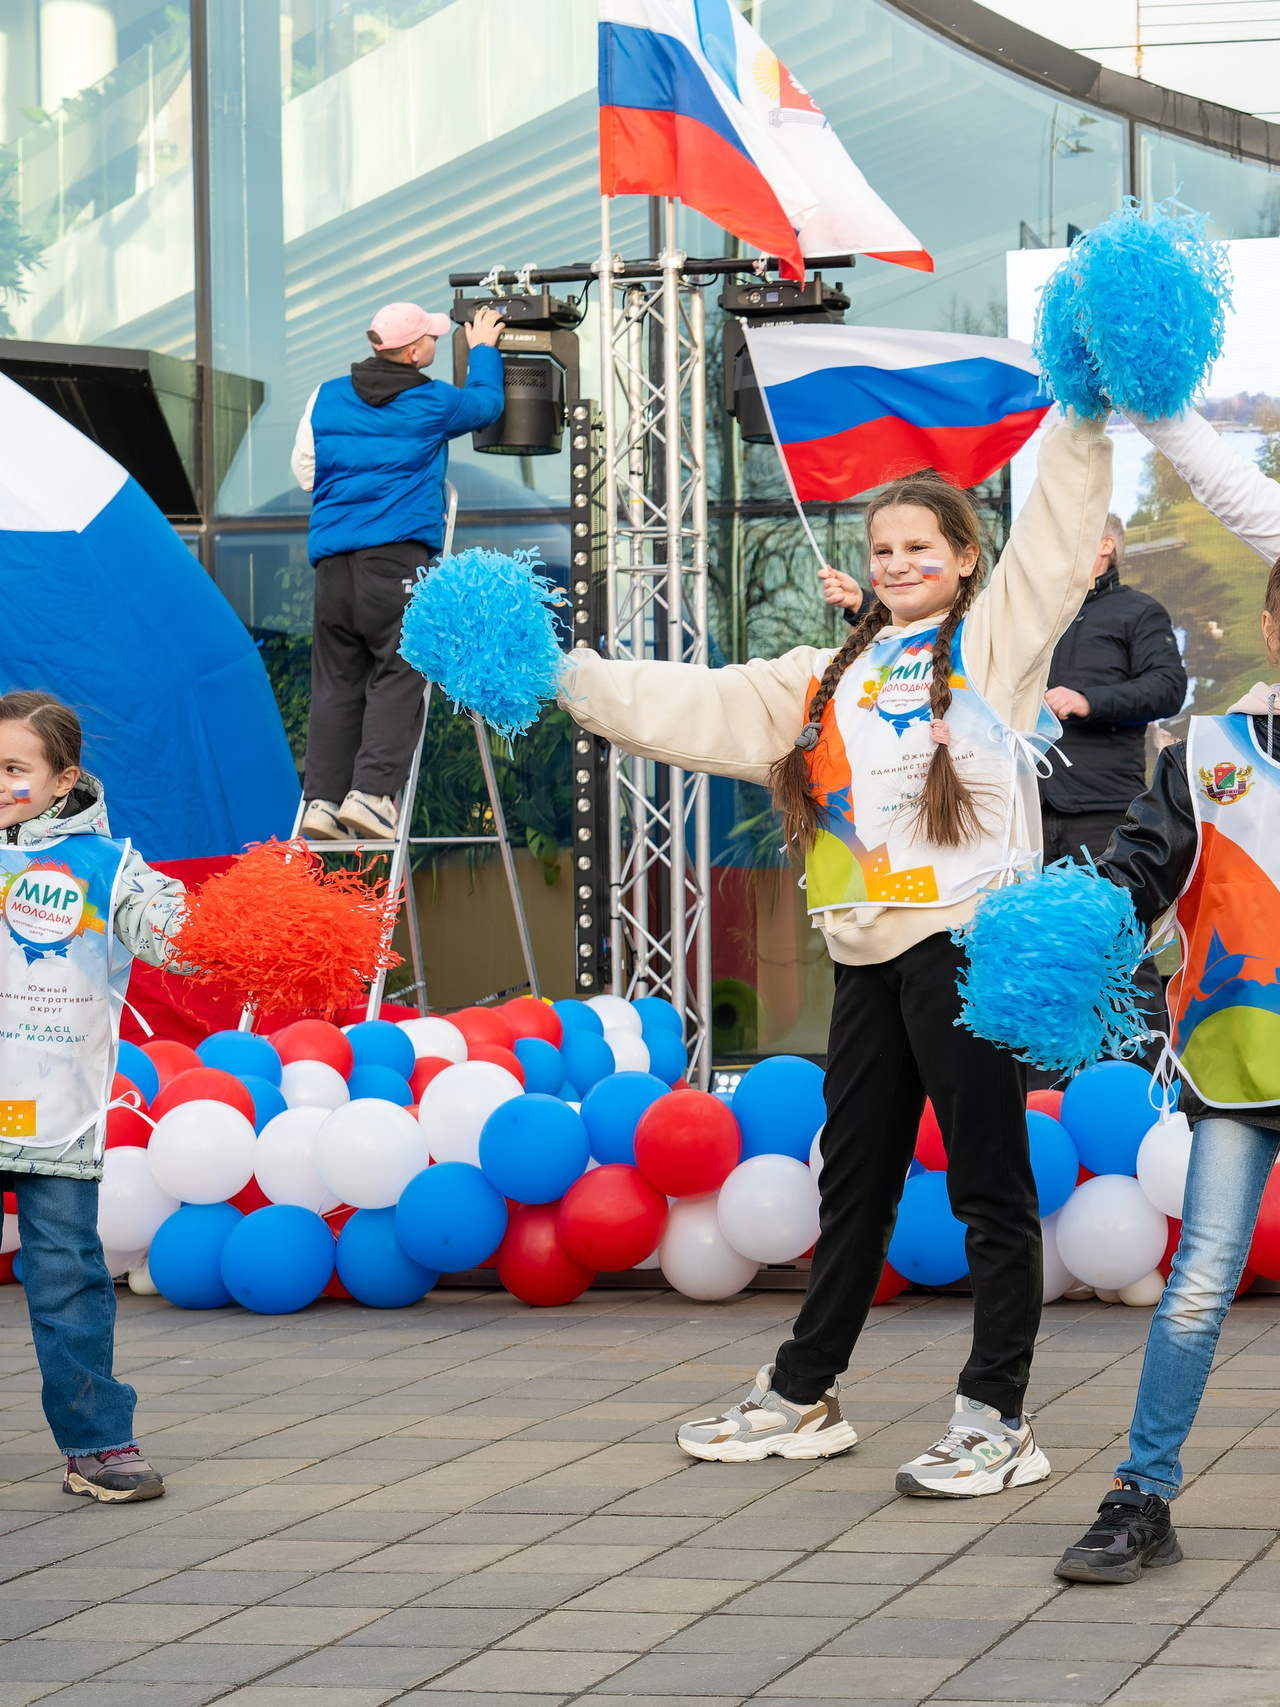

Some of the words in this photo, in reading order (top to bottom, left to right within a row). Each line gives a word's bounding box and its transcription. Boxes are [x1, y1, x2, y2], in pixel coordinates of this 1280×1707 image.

[901, 752, 932, 761] Южны
[907, 772, 927, 780] окр
[15, 878, 79, 911] МИР
[11, 901, 73, 925] МОЛОДЫХ
[28, 984, 68, 994] Южный
[29, 1005, 62, 1014] округ
[18, 1023, 39, 1032] ГБУ
[44, 1025, 71, 1034] ДСЦ
